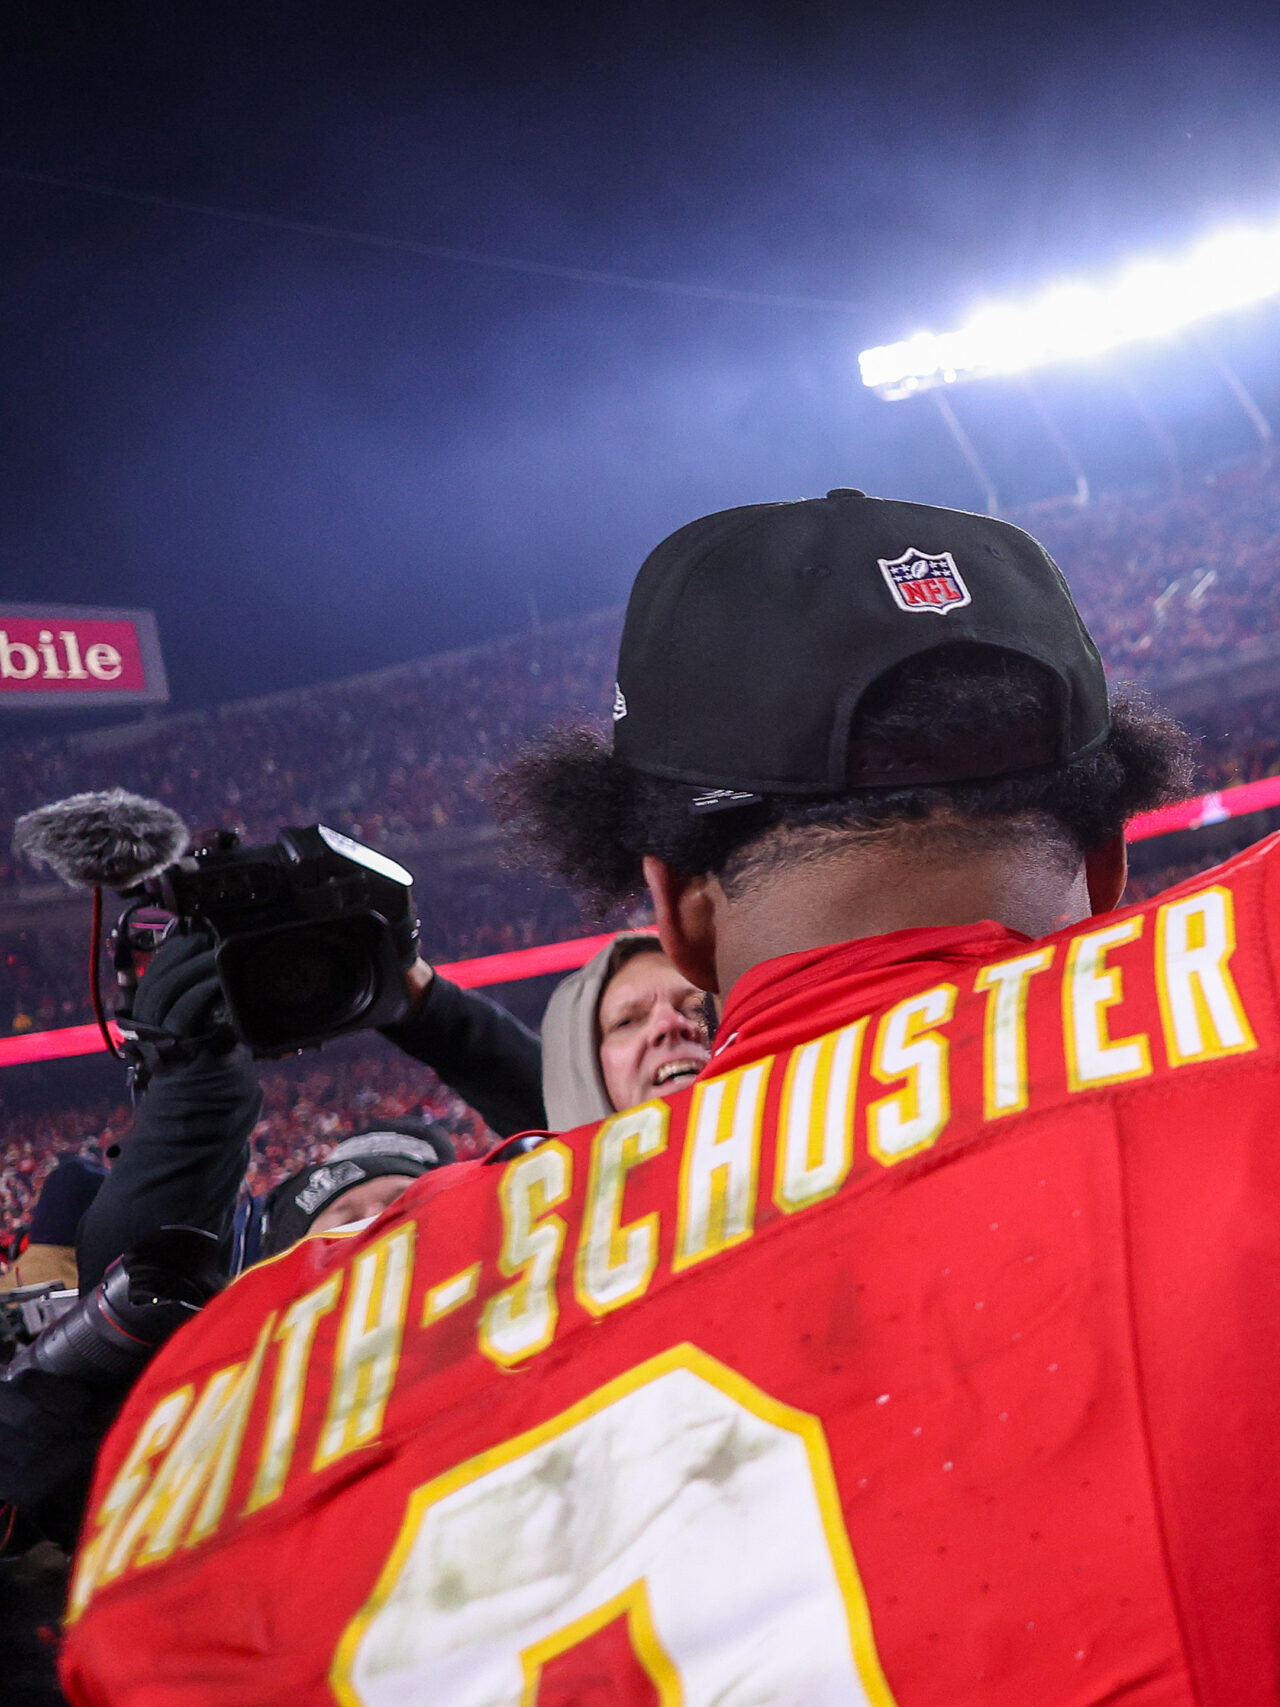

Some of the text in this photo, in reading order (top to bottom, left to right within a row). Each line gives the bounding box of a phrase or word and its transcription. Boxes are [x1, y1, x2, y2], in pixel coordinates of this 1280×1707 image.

[899, 577, 961, 604] NFL
[0, 630, 122, 681] bile
[63, 885, 1258, 1624] SMITH-SCHUSTER
